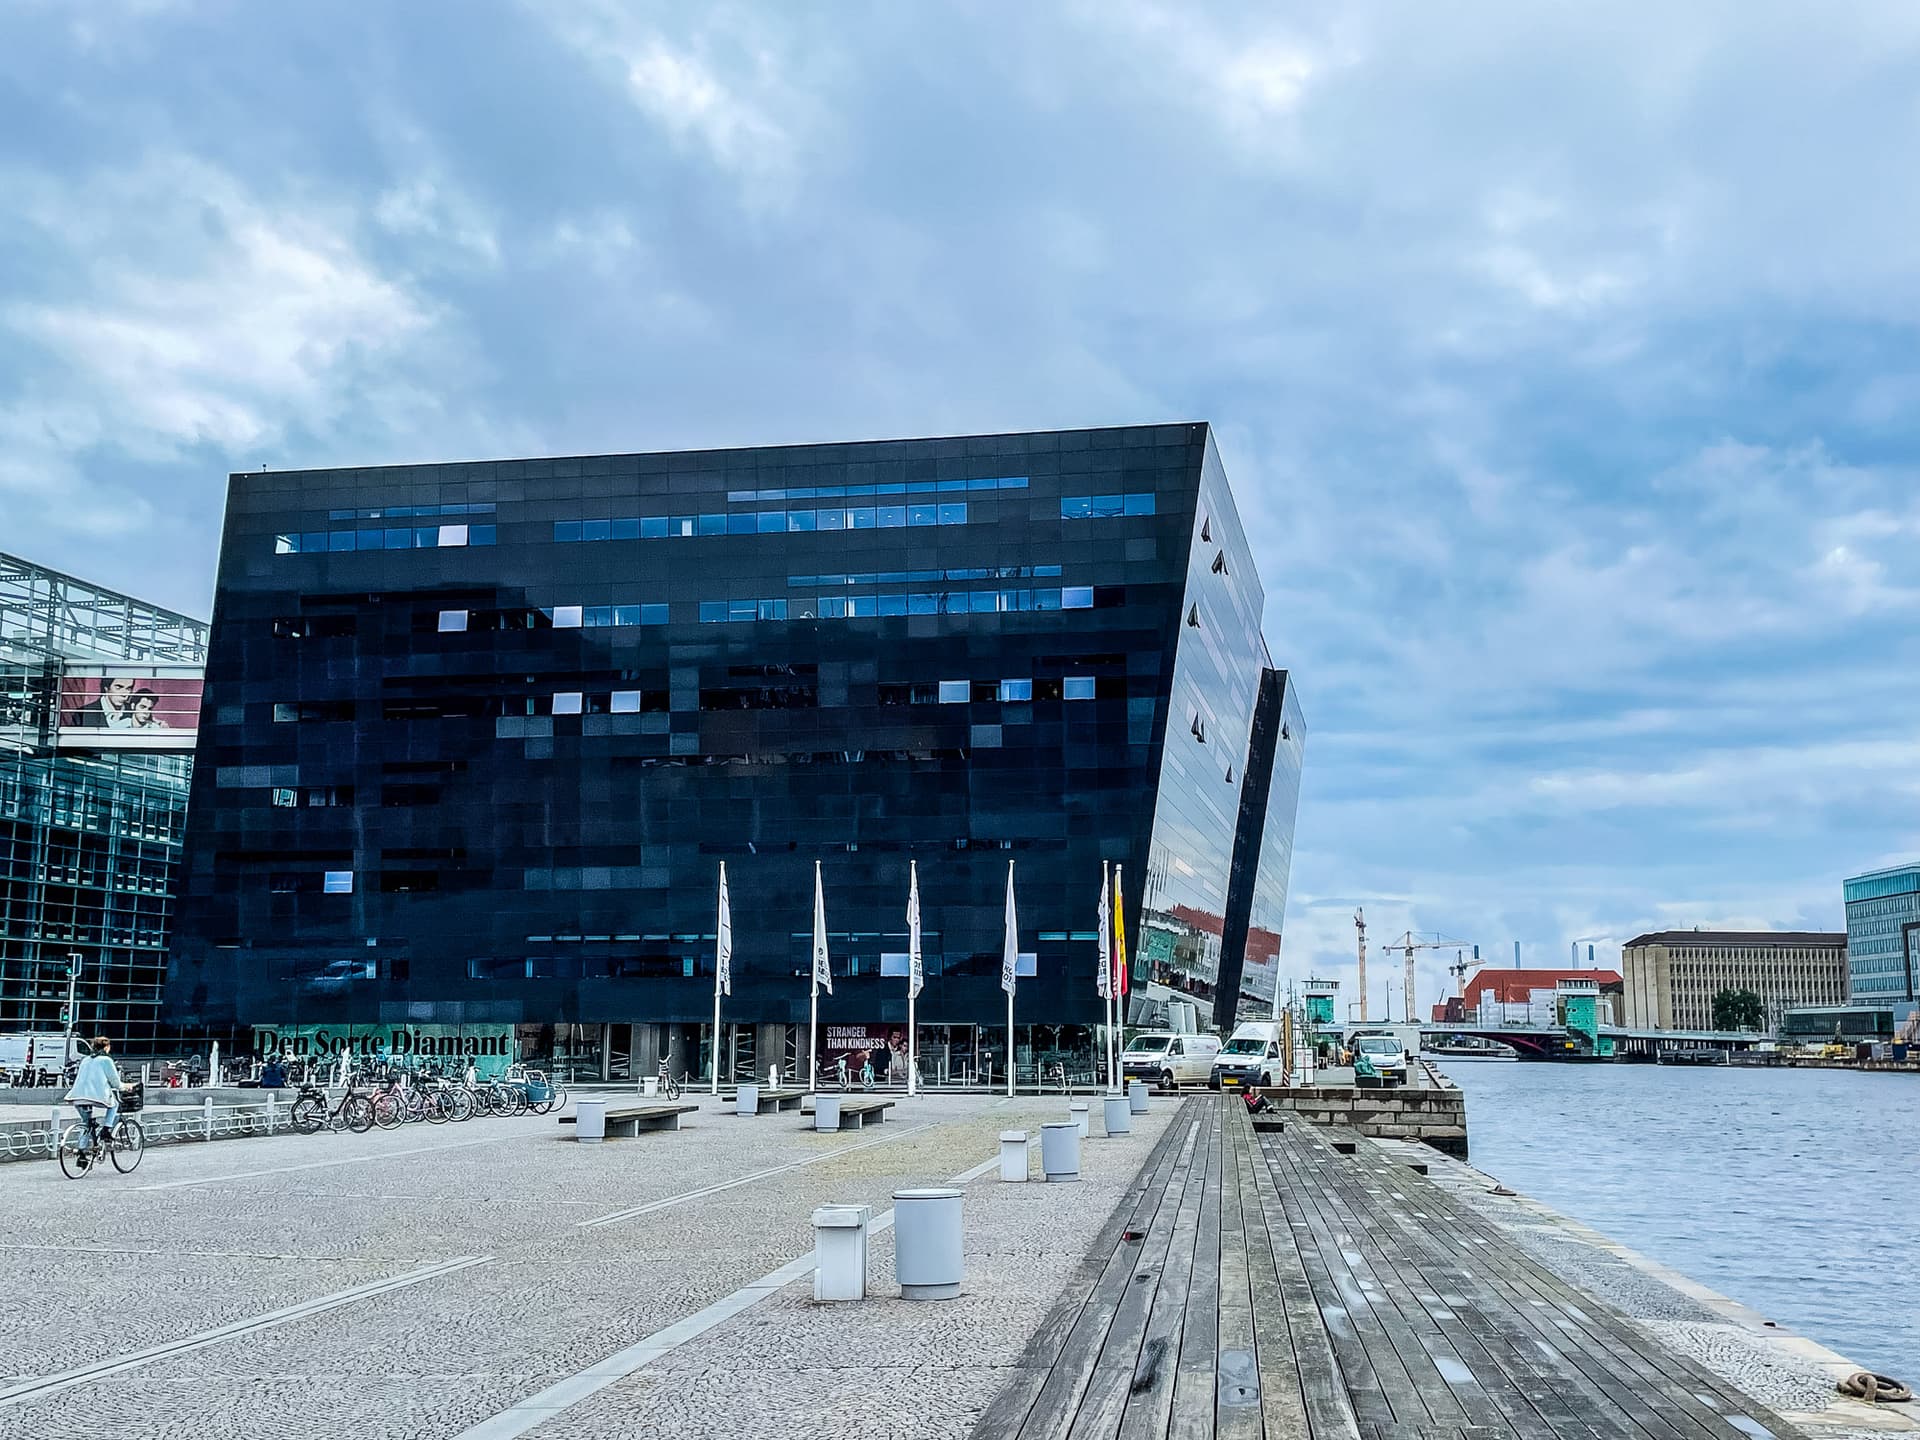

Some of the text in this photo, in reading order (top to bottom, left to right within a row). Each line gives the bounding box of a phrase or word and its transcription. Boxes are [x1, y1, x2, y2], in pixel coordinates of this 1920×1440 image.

[826, 1026, 867, 1037] STRANGER
[257, 1029, 509, 1056] Den Sorte Diamant
[826, 1038, 886, 1049] THAN KINDNESS
